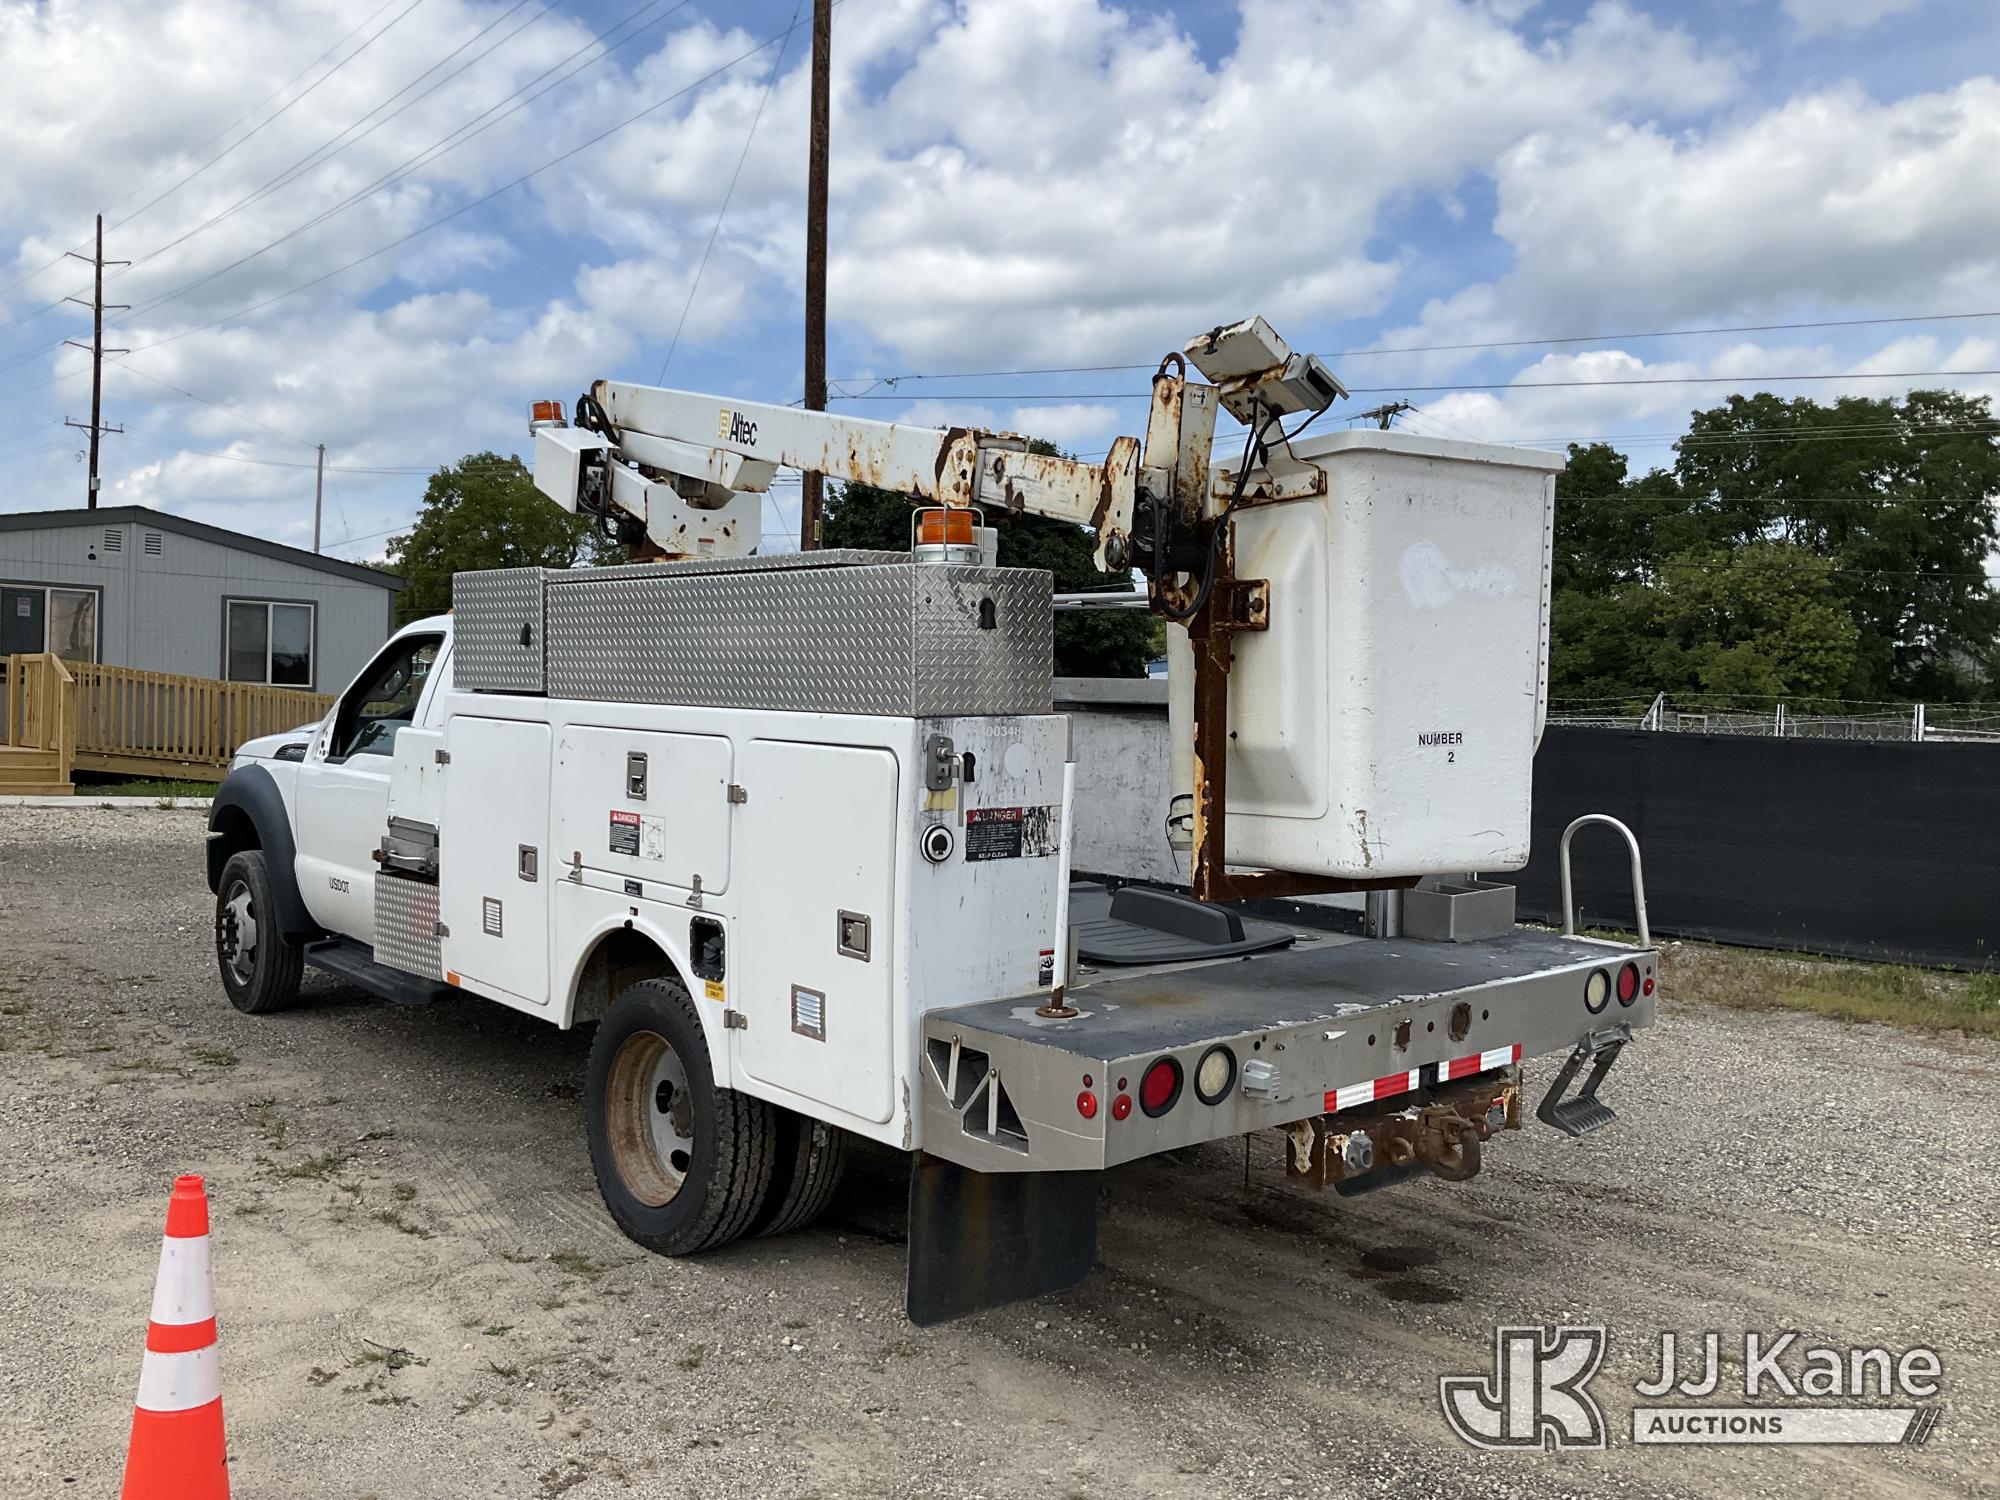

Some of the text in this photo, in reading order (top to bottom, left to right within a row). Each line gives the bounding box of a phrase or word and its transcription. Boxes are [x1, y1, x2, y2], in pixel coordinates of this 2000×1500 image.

[729, 411, 758, 446] Altec
[1418, 732, 1462, 745] NUMBER
[1447, 751, 1455, 763] 2
[617, 813, 638, 824] DANGER
[329, 876, 350, 894] USDOT
